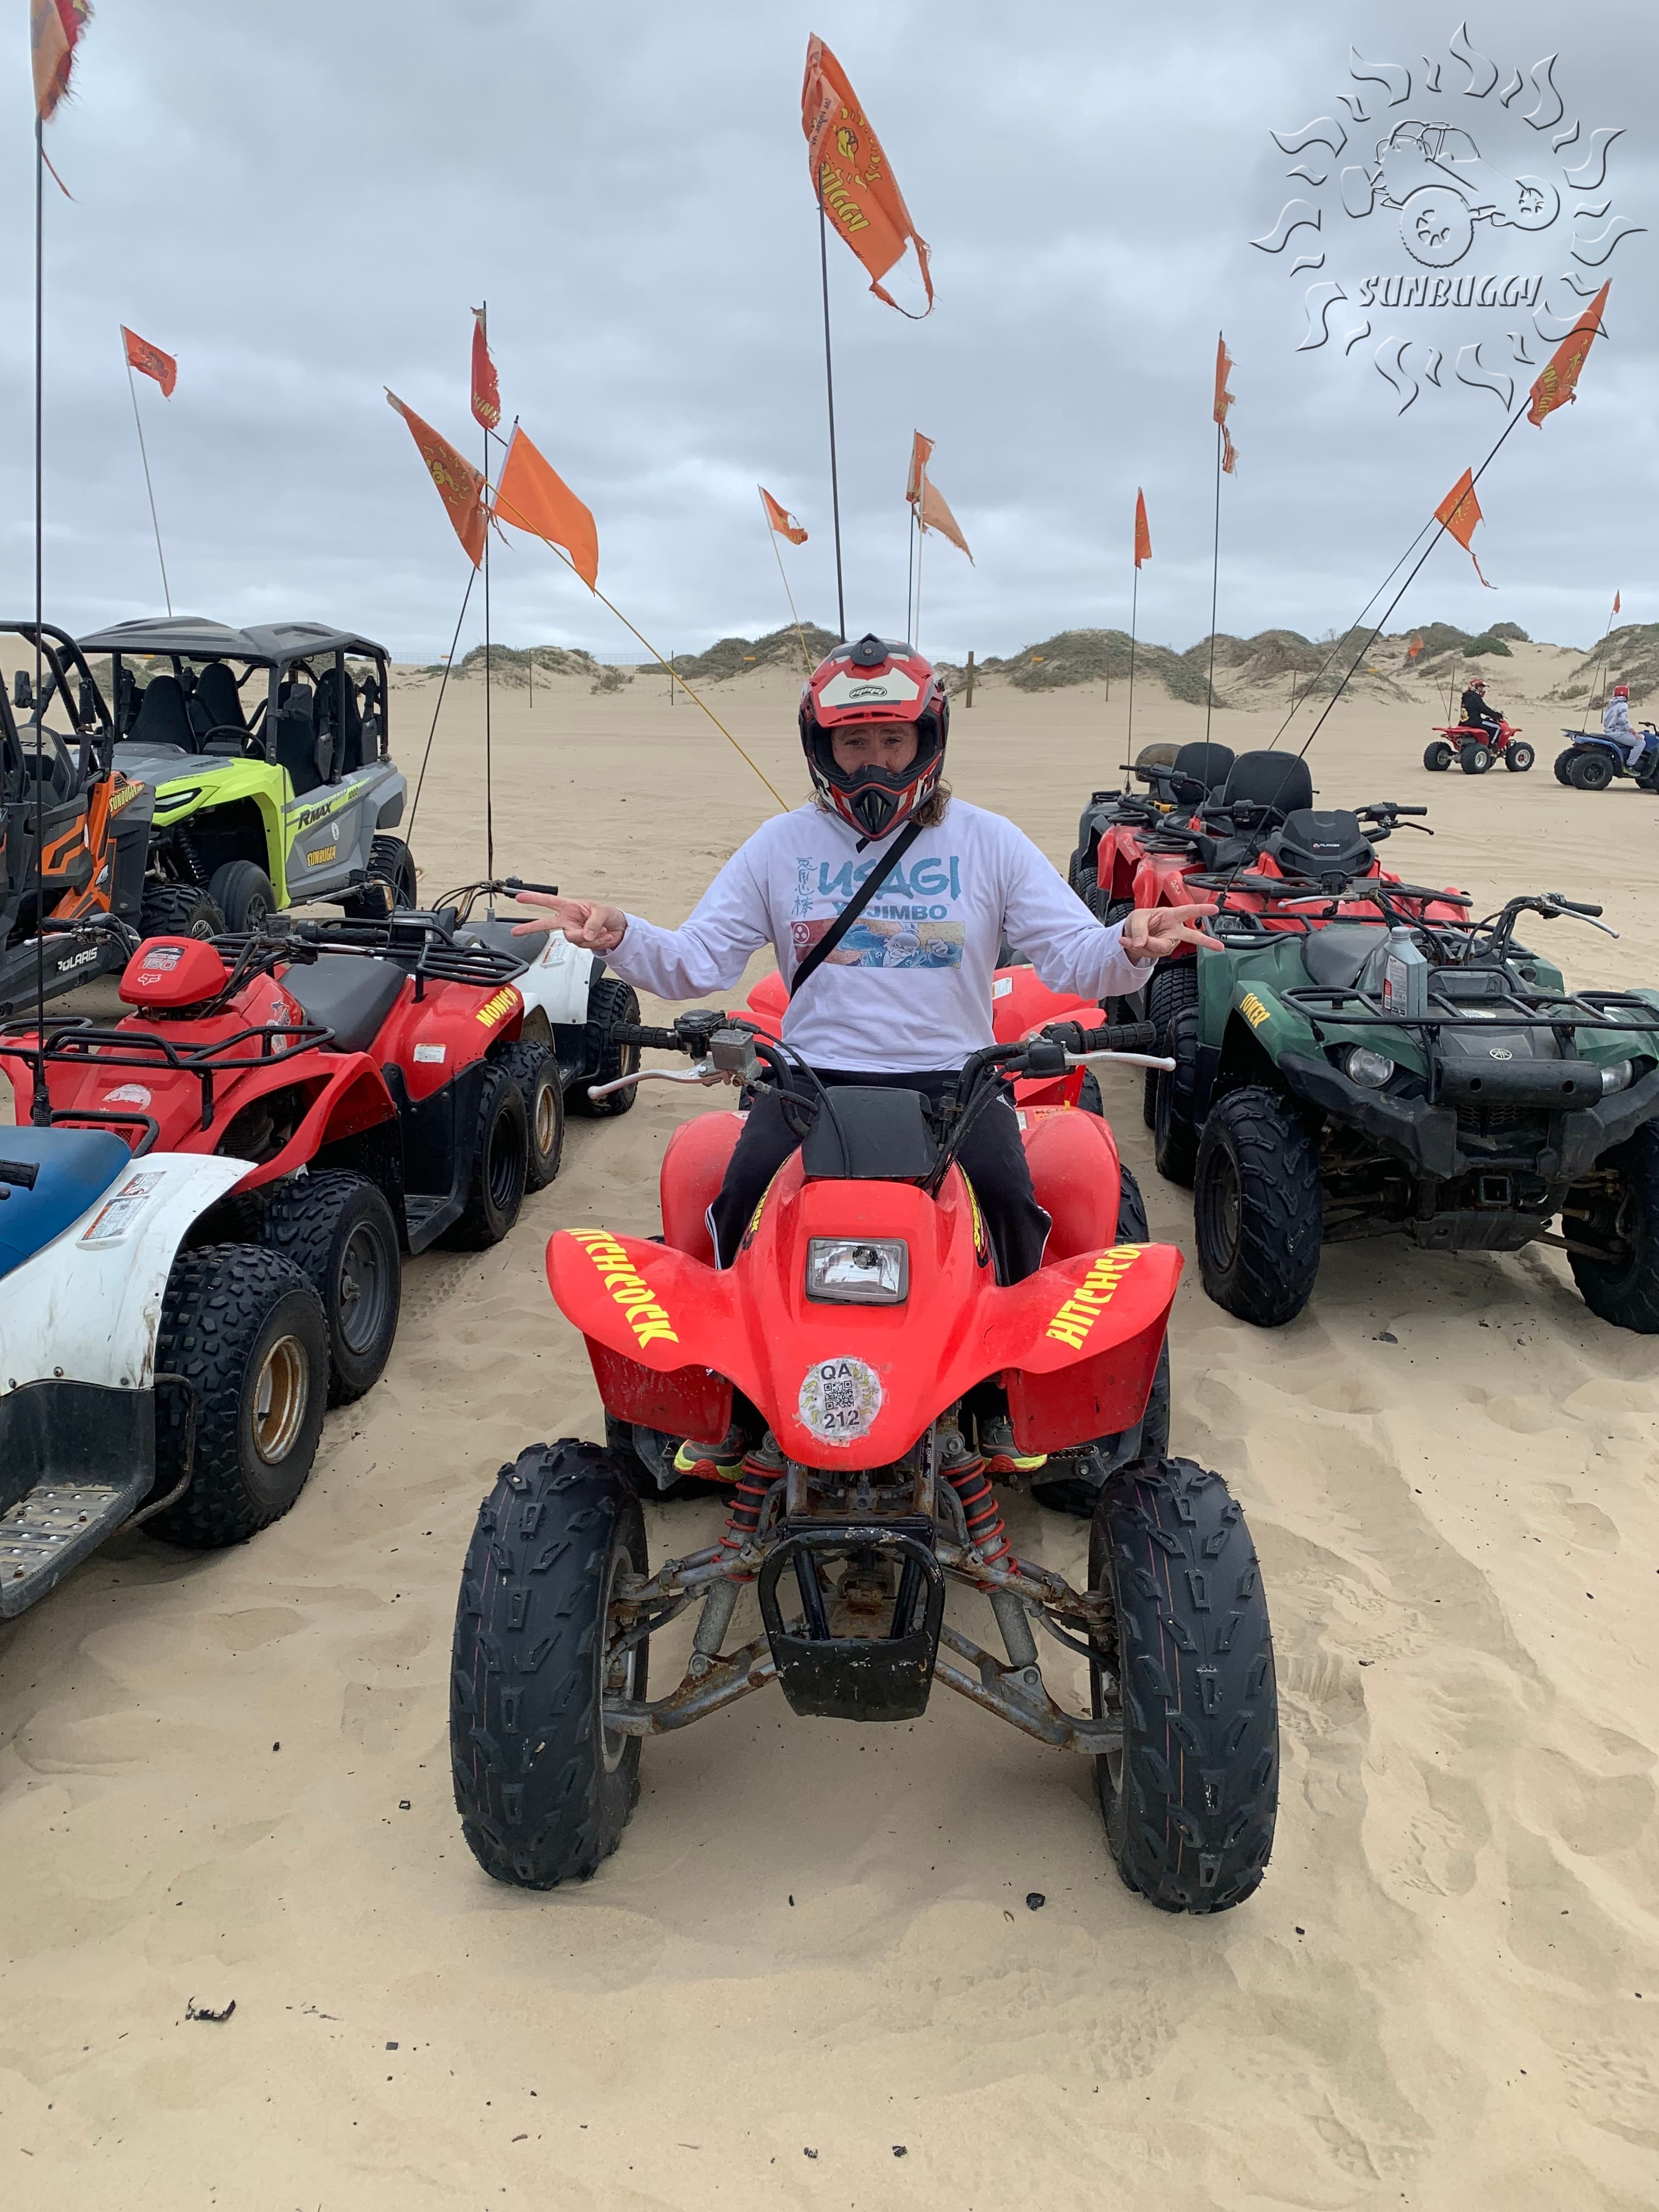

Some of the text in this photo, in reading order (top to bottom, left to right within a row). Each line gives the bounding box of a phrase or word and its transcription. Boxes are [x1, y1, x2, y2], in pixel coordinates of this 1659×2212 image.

[297, 801, 332, 831] RMAX
[307, 844, 336, 867] SUNBUGGY
[832, 901, 947, 921] YJIMBO
[58, 946, 98, 972] POLARIS
[142, 957, 176, 971] 150
[475, 986, 518, 1028] MONICA
[821, 1363, 852, 1381] QA
[824, 1410, 860, 1429] 212
